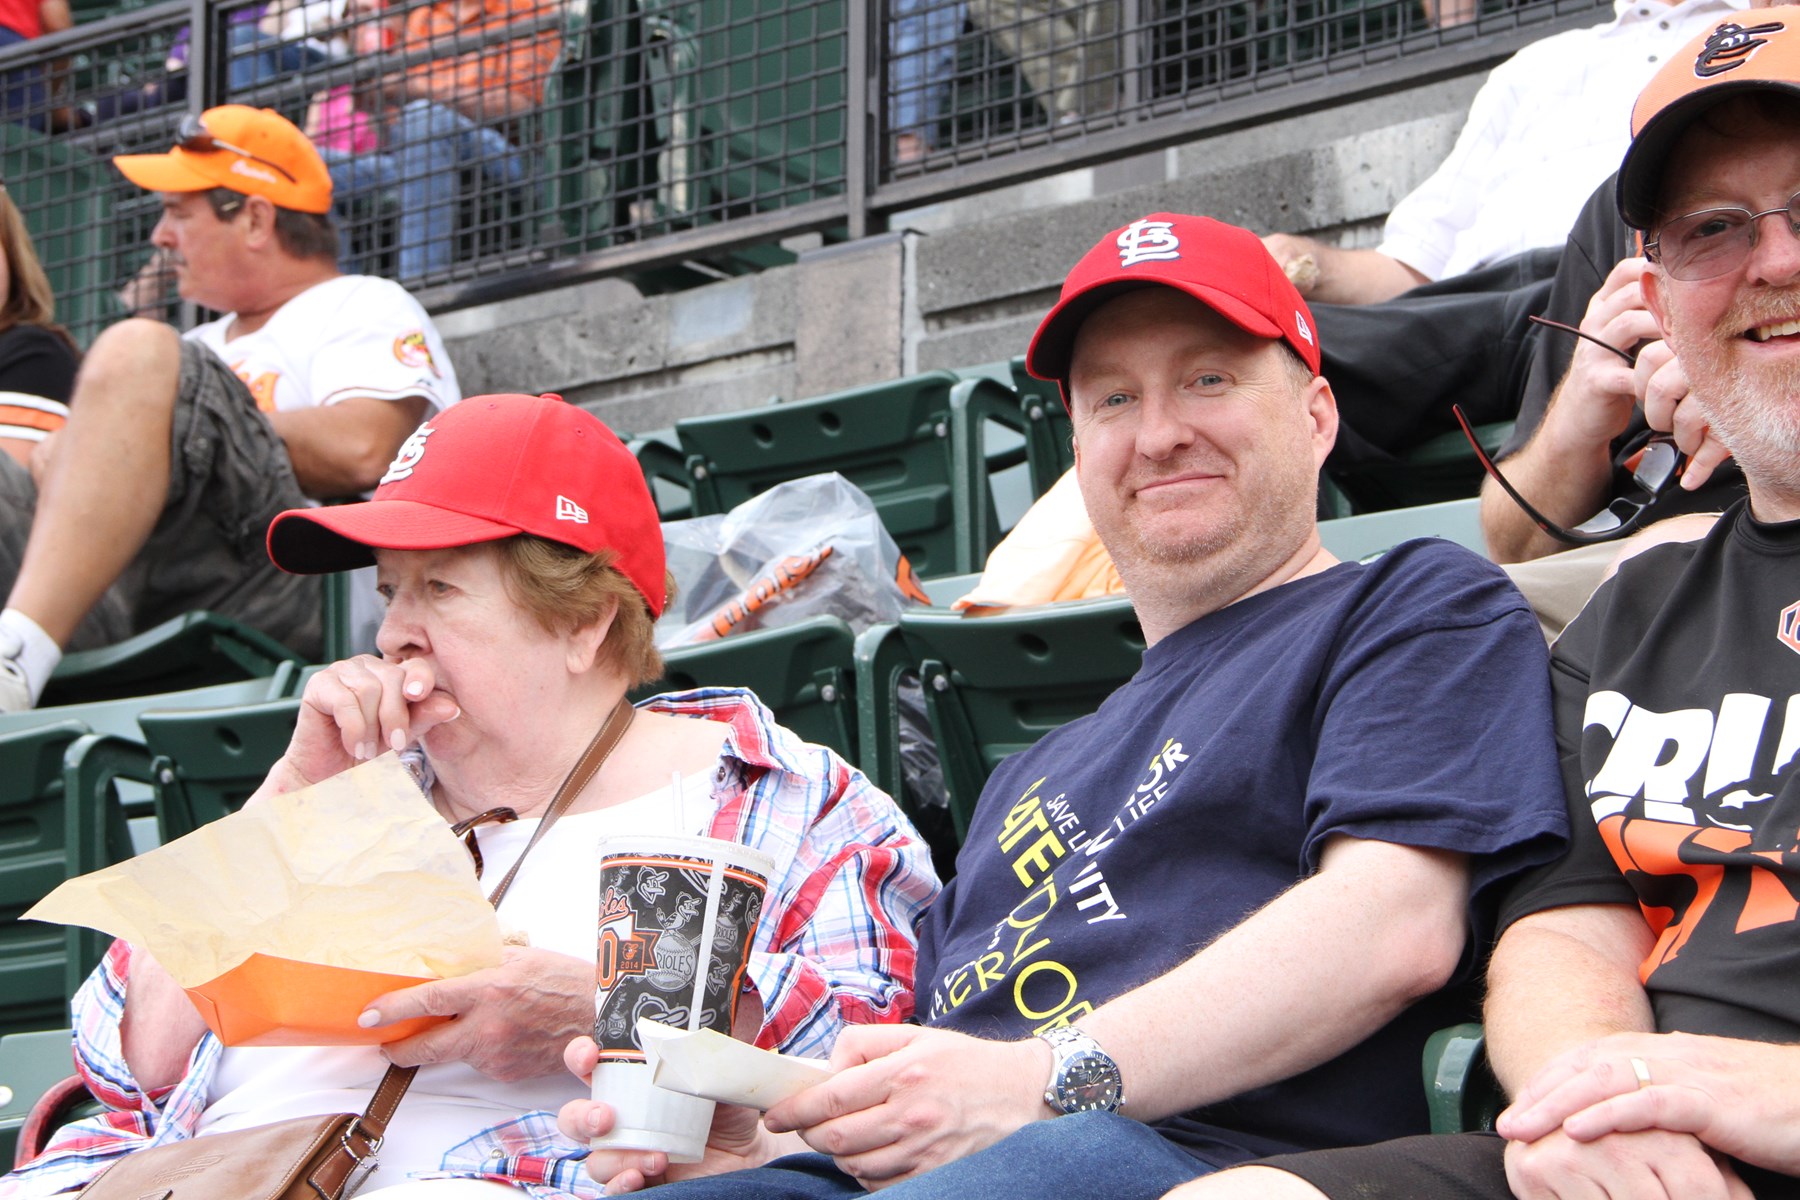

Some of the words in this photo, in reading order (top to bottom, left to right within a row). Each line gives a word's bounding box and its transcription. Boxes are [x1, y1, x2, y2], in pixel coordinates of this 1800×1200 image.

[1046, 793, 1080, 835] SAVE
[620, 961, 639, 970] 2014
[656, 952, 694, 976] RIOLES
